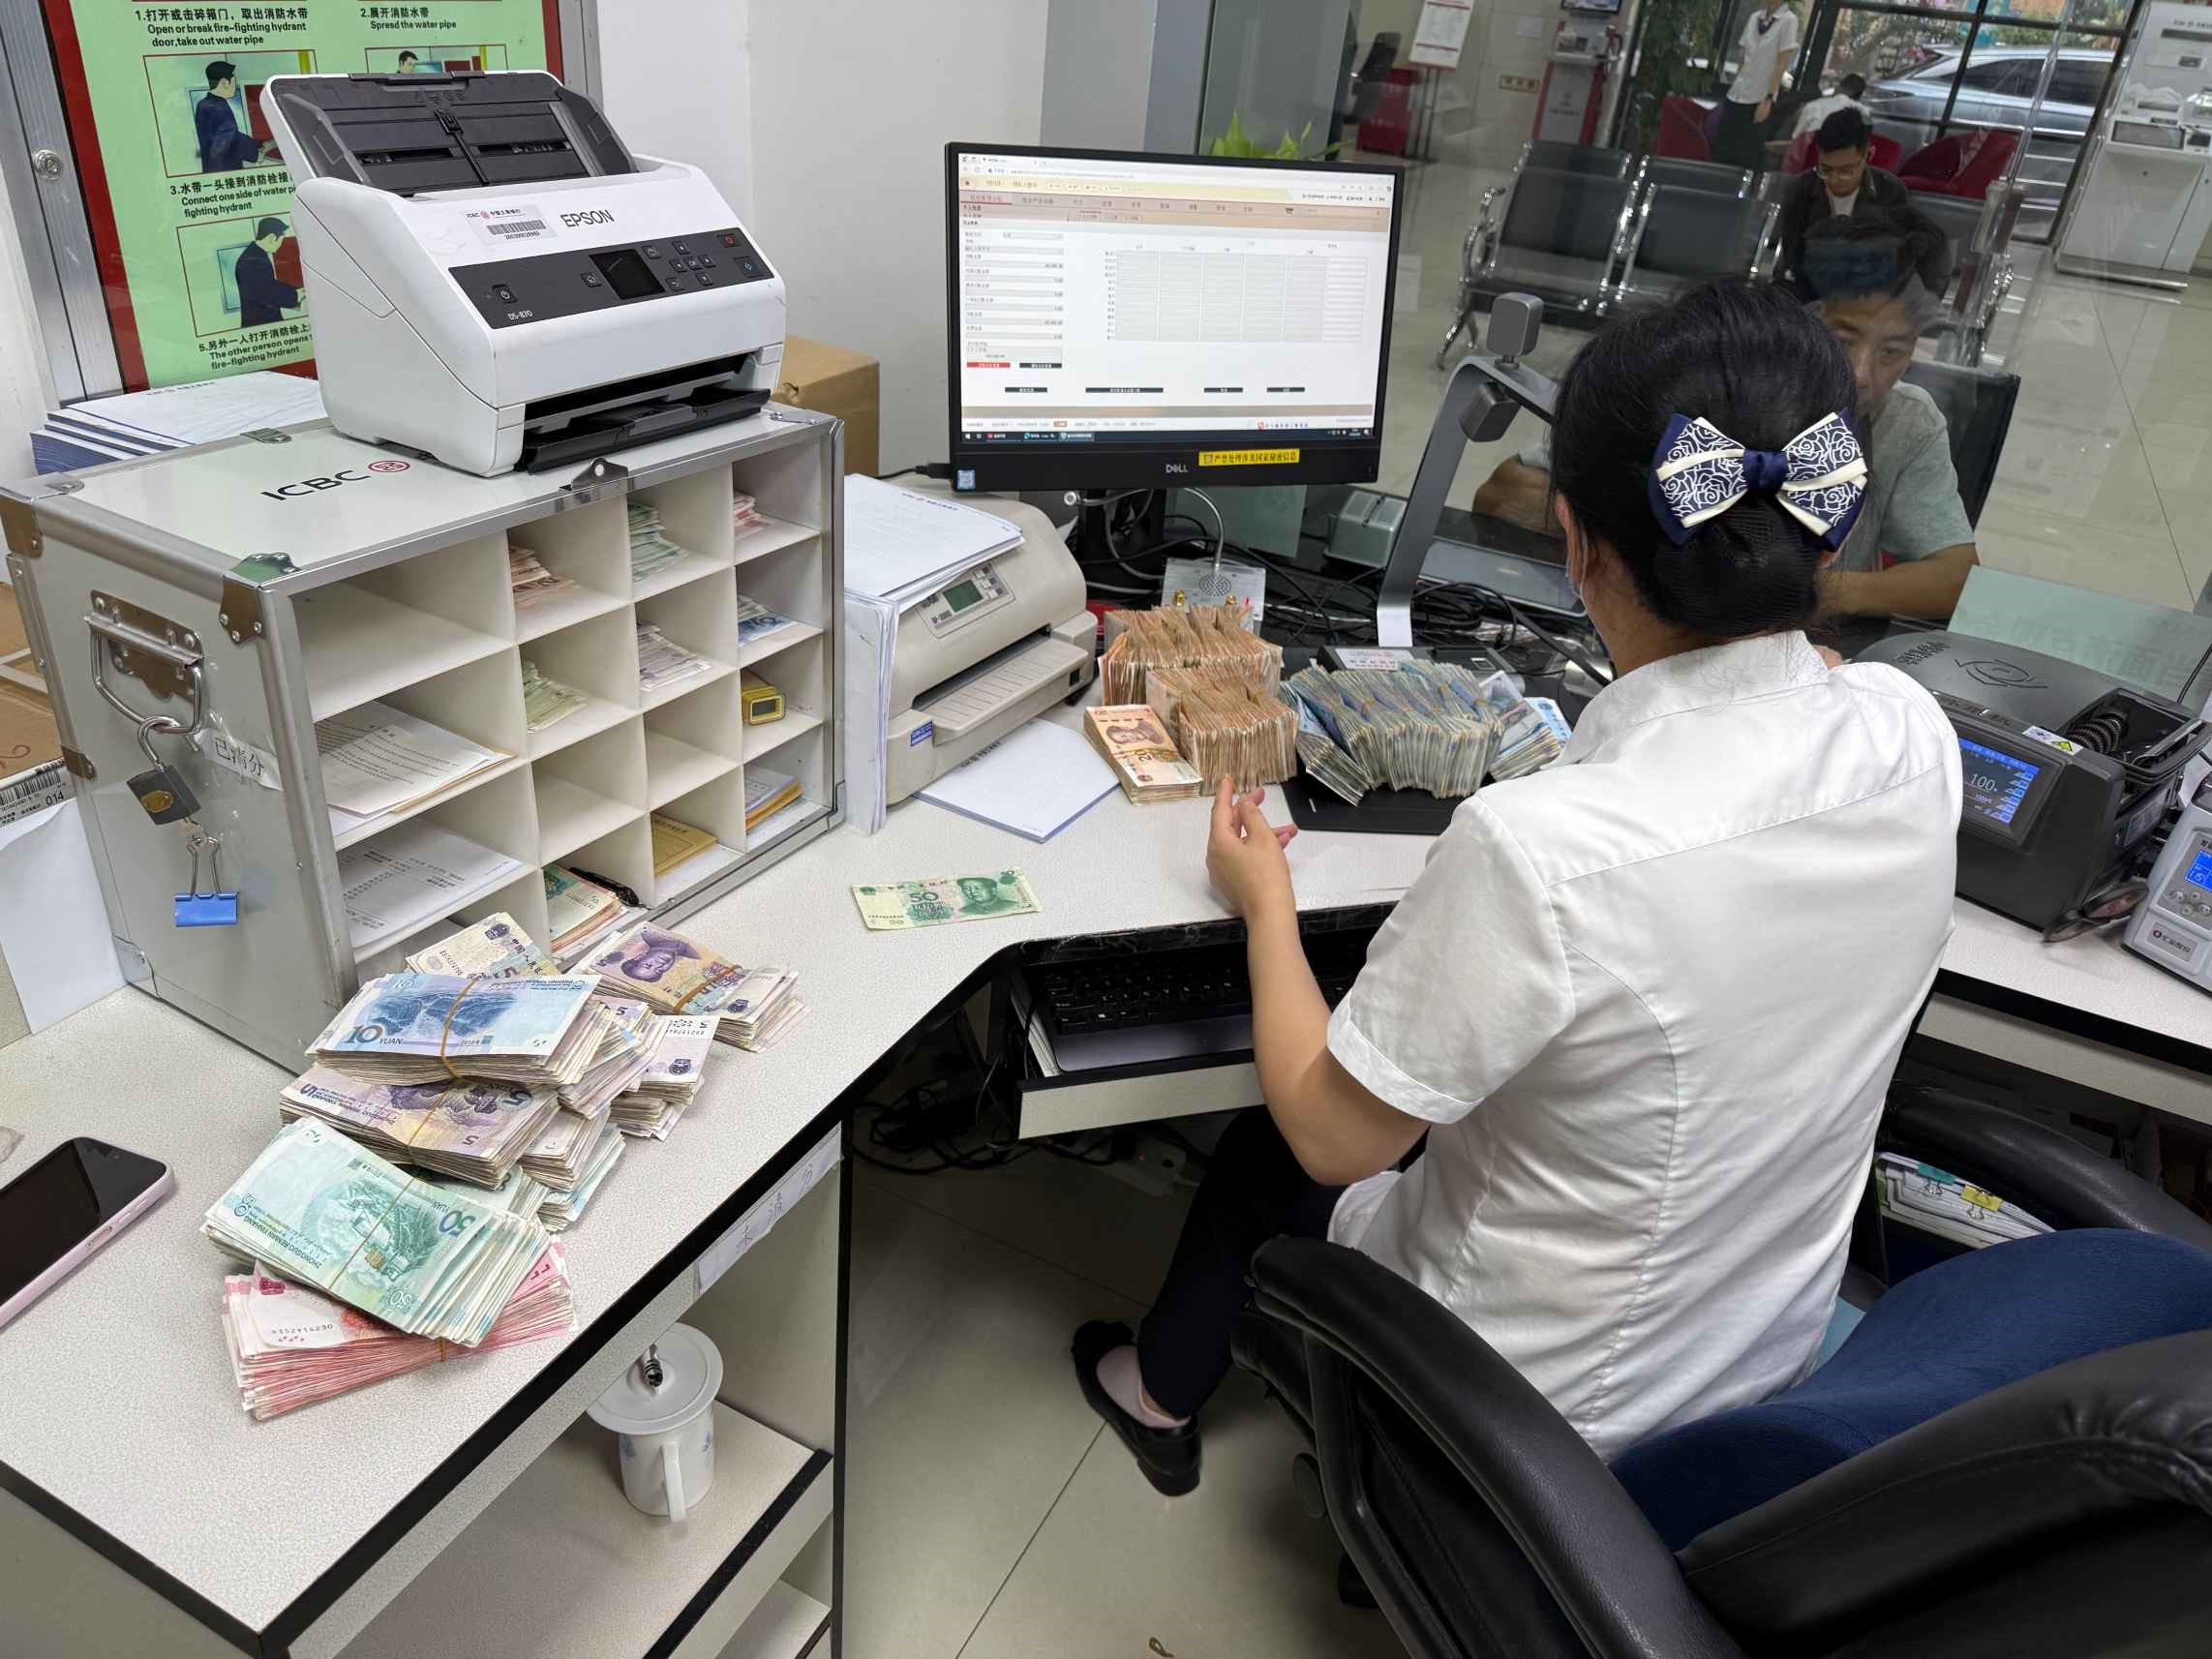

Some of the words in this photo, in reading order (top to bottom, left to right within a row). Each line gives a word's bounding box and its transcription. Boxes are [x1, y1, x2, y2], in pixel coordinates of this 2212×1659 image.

[360, 7, 429, 18] 2.展开消防水带
[147, 24, 177, 35] Open
[176, 25, 186, 34] or
[187, 23, 214, 33] break
[214, 22, 271, 33] fire-fighting
[271, 22, 307, 32] hydrant
[401, 20, 415, 29] the
[415, 20, 438, 29] water
[439, 20, 457, 30] pipe
[198, 37, 215, 45] out
[216, 37, 243, 45] water
[244, 35, 264, 45] pipe
[181, 195, 219, 206] Connect
[236, 190, 254, 200] side
[254, 189, 263, 197] of
[262, 186, 288, 196] water
[184, 206, 220, 219] fighting
[219, 201, 253, 214] hydrant
[560, 209, 616, 228] EPSON
[209, 350, 227, 361] The
[227, 346, 252, 356] other
[252, 341, 283, 352] person
[284, 335, 309, 347] opens
[266, 346, 300, 359] hydrant
[1166, 464, 1189, 473] DELL
[260, 470, 373, 501] ICBC
[1971, 773, 1996, 792] 100
[45, 790, 64, 806] 014
[909, 890, 939, 903] 50
[344, 1024, 384, 1044] 10
[439, 1210, 476, 1239] 50
